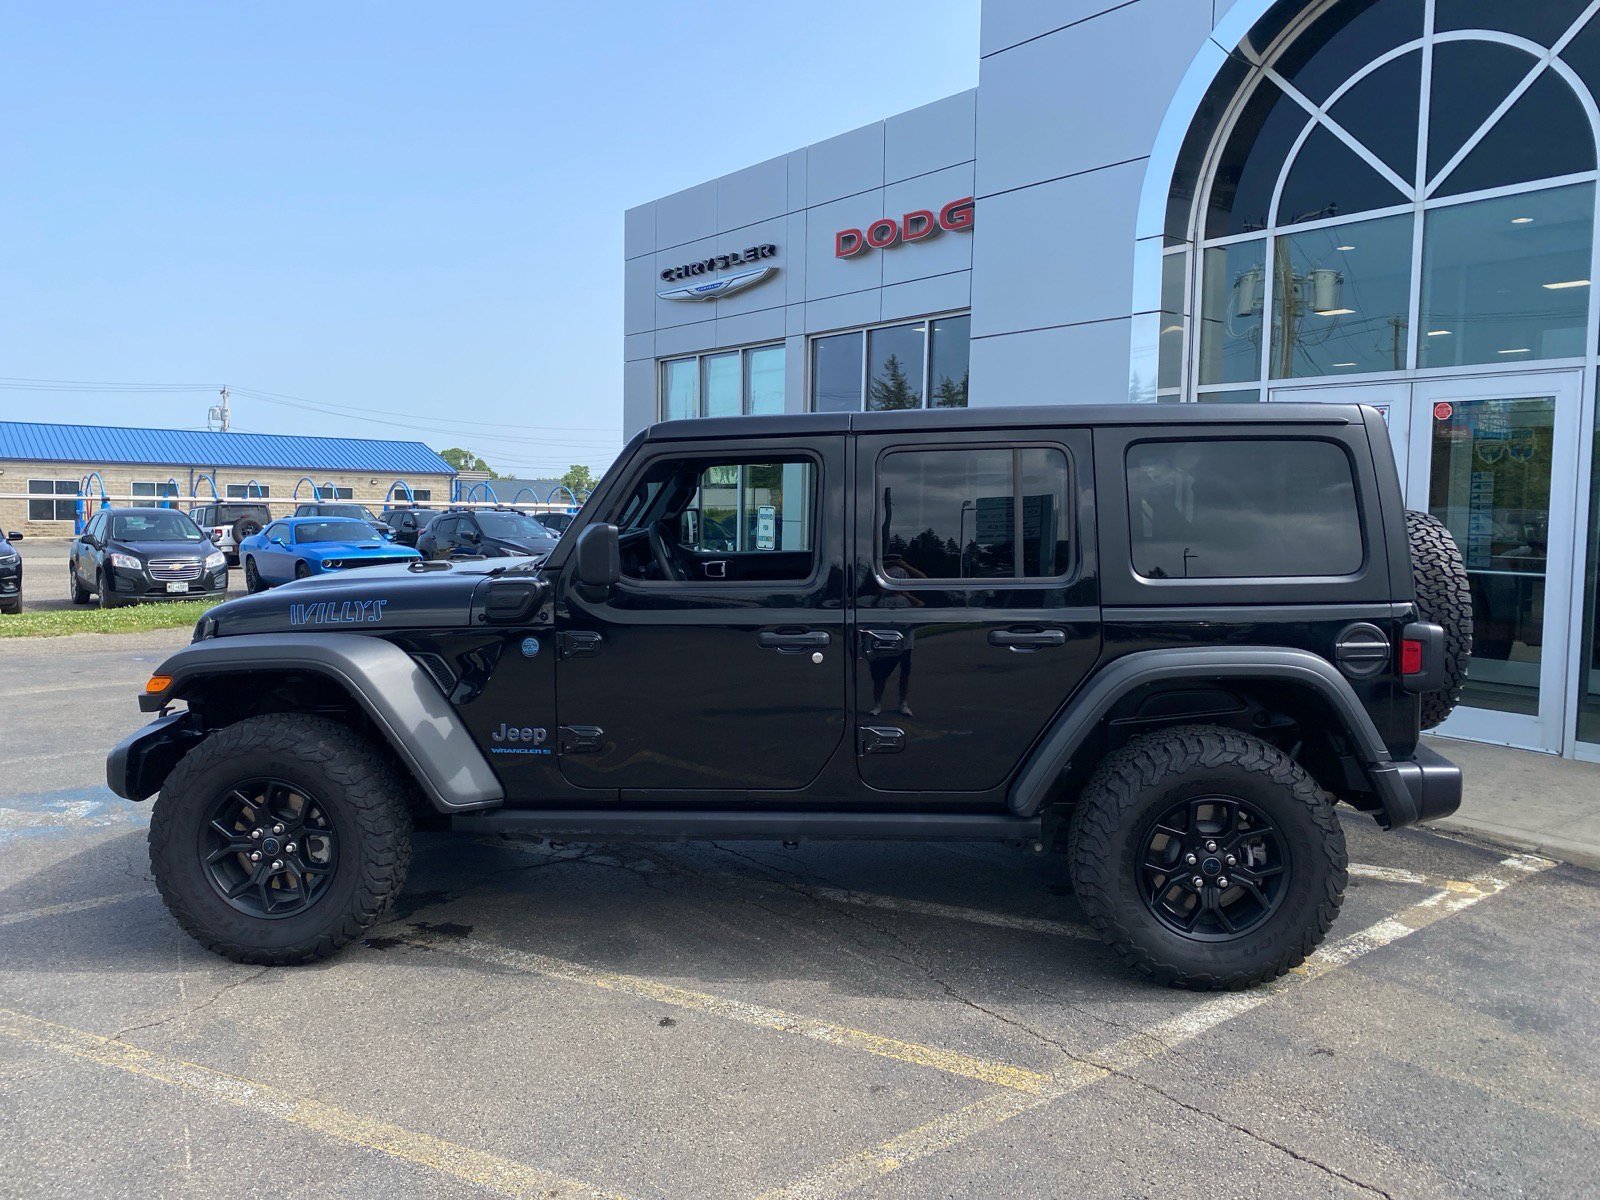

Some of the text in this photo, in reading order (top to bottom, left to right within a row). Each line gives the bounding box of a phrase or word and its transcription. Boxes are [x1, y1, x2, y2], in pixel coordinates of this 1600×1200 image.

[835, 196, 974, 258] DODG
[660, 243, 776, 282] CHRYSLER
[290, 600, 387, 625] WILLYS
[491, 723, 547, 745] Jeep
